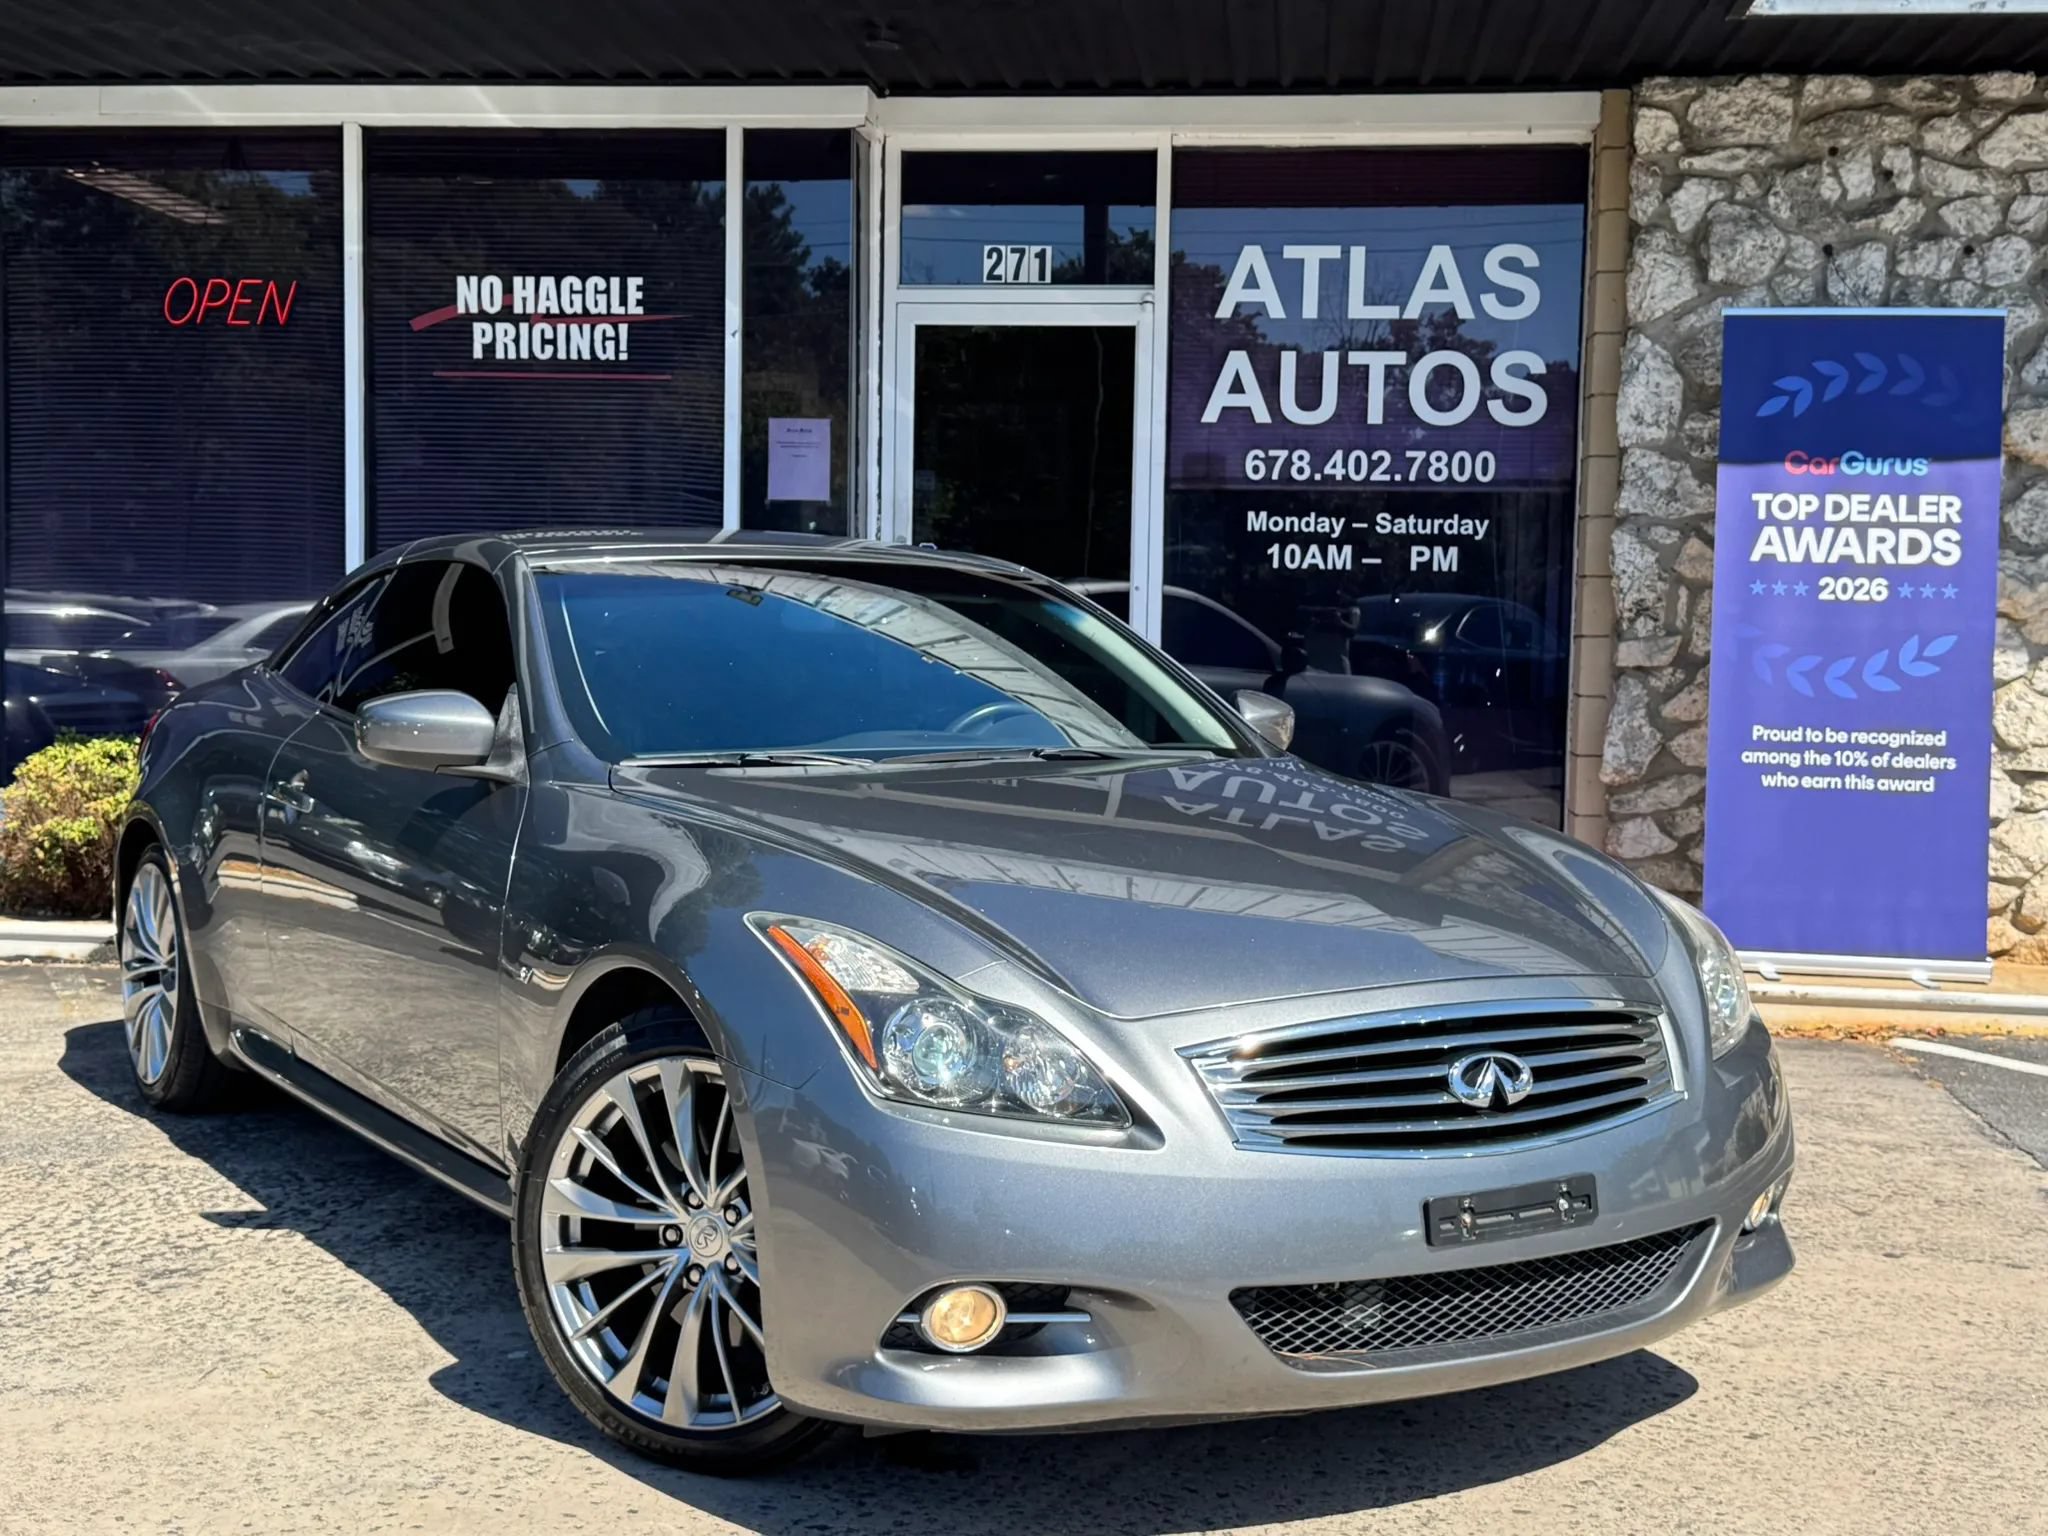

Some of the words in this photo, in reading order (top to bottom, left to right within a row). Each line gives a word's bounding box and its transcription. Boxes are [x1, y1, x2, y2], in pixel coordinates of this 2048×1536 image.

[986, 246, 1046, 282] 271
[455, 275, 503, 316] NO
[512, 275, 644, 316] HAGGLE
[1214, 244, 1541, 321] ATLAS
[163, 276, 297, 328] OPEN
[471, 322, 628, 361] PRICING!
[1200, 350, 1548, 427] AUTOS
[1244, 449, 1496, 483] 678.402.7800
[1784, 450, 1929, 476] CarGurus
[1751, 493, 1820, 522] TOP
[1823, 494, 1963, 524] DEALER
[1246, 510, 1346, 538] Monday
[1375, 512, 1490, 540] Saturday
[1266, 543, 1353, 570] 10AM
[1409, 546, 1459, 572] PM
[1749, 525, 1963, 566] AWARDS
[1817, 576, 1890, 602] 2026
[1752, 724, 1803, 743] Proud
[1805, 727, 1824, 743] to
[1825, 726, 1849, 744] be
[1850, 730, 1947, 748] recognized
[1741, 750, 1801, 768] among
[1803, 749, 1832, 766] the
[1833, 749, 1869, 767] 10%
[1870, 752, 1891, 768] of
[1891, 752, 1957, 770] dealers
[1761, 772, 1799, 788] who
[1800, 774, 1842, 789] earn
[1844, 774, 1875, 790] this
[1876, 776, 1935, 792] award
